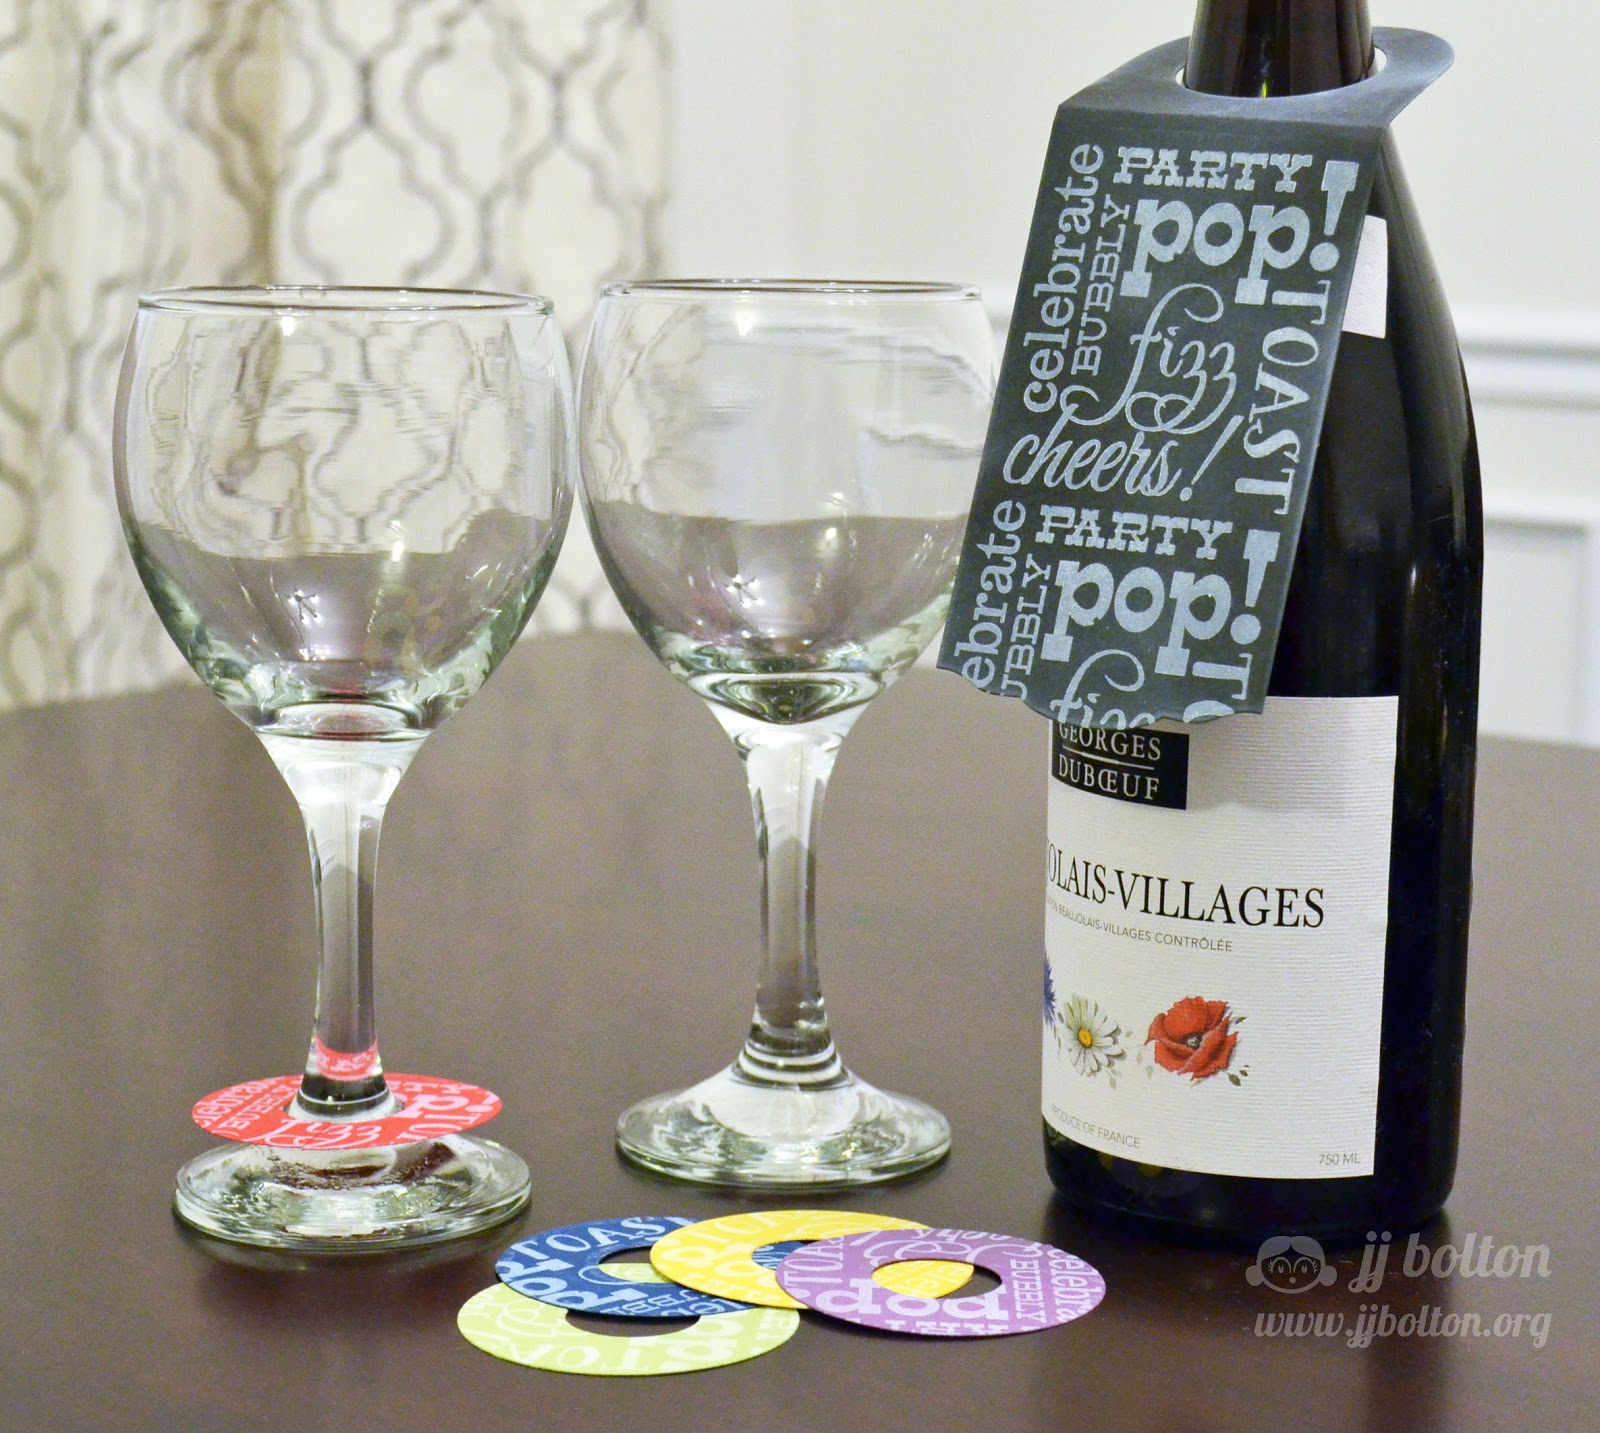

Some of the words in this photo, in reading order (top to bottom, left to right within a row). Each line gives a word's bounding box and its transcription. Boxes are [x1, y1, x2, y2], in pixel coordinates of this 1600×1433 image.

[1113, 146, 1313, 193] PARTY
[1023, 144, 1104, 413] celebrate
[1071, 194, 1131, 375] BUBBLY
[1120, 161, 1360, 305] pop!
[1060, 283, 1237, 435] fizz
[1235, 280, 1330, 515] TOAST
[1002, 413, 1244, 501] cheers!
[1035, 504, 1233, 560] PARTY
[1041, 529, 1281, 677] pop!
[1060, 722, 1161, 761] GEORGES
[1082, 1121, 1096, 1135] OF
[1097, 1126, 1141, 1149] FRANCE
[1319, 1153, 1340, 1166] 750
[1342, 1152, 1361, 1165] ML
